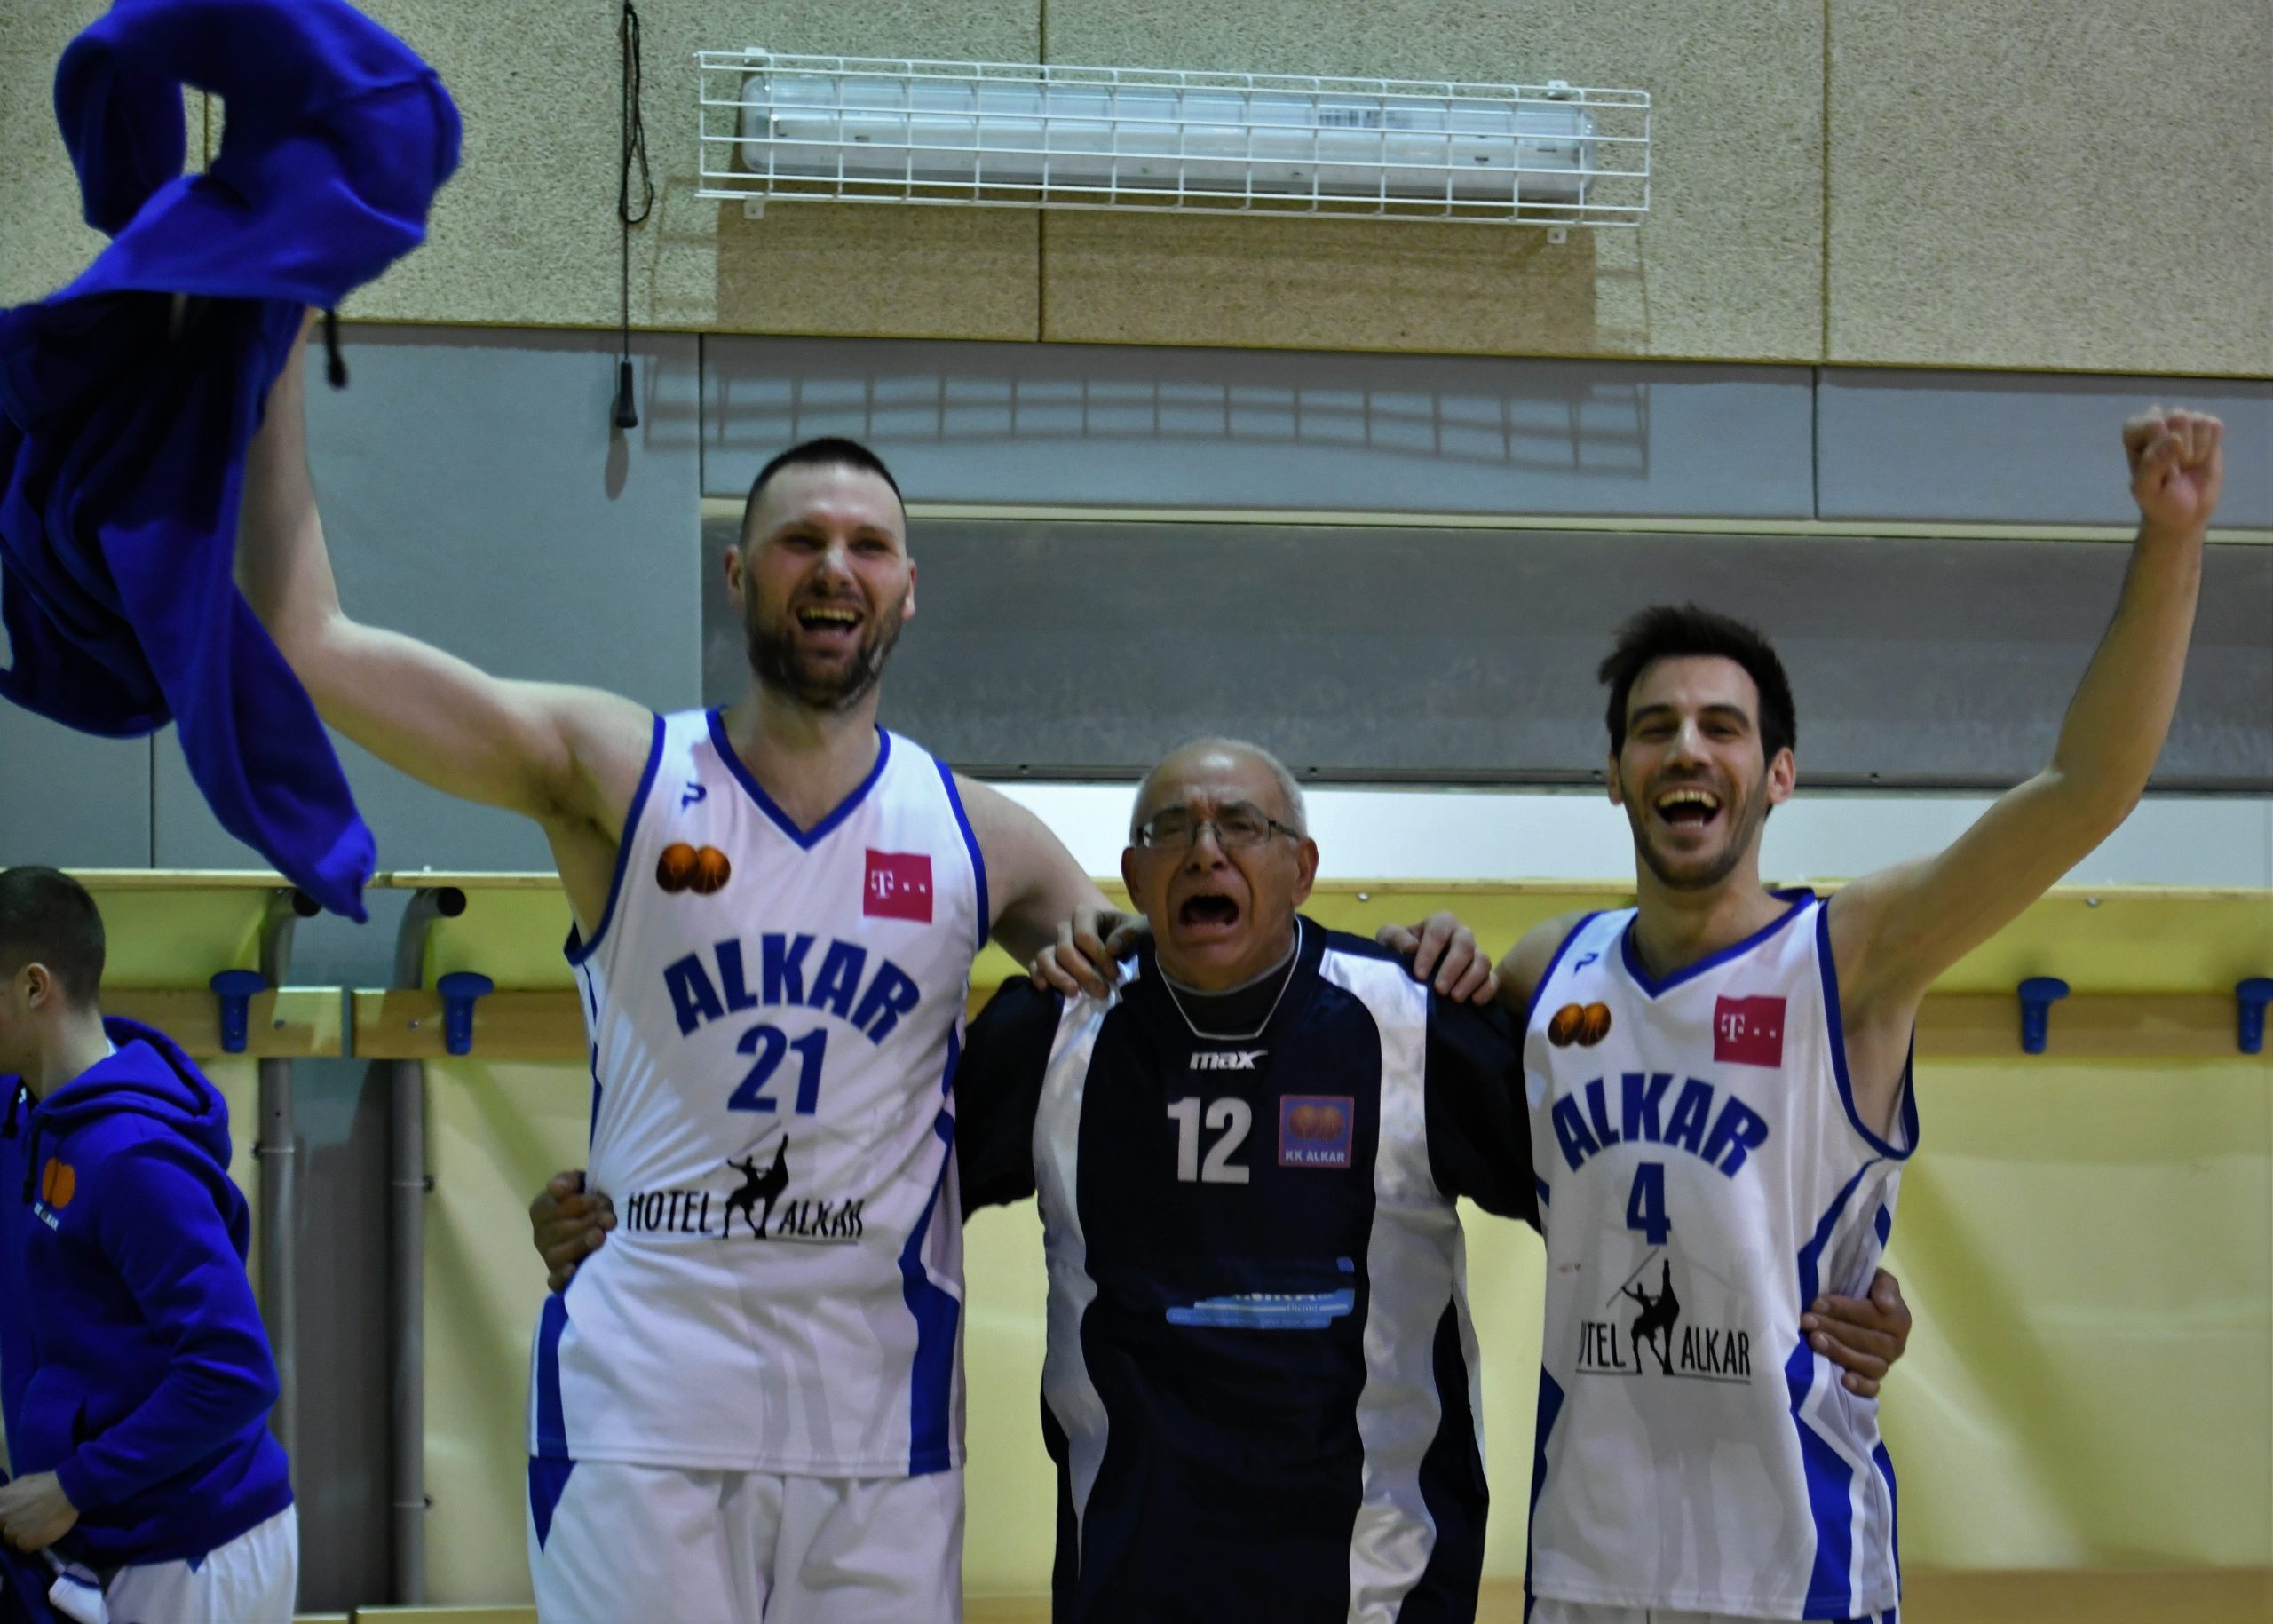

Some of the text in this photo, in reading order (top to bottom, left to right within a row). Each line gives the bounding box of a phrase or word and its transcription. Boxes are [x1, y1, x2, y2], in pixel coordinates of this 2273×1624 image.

[663, 932, 920, 1047] ALKAR
[727, 1024, 828, 1114] 21
[1189, 1050, 1269, 1070] max
[1167, 1096, 1252, 1184] 12
[1285, 1150, 1344, 1163] KK ALKAR
[1552, 1073, 1768, 1179] ALKAR
[627, 1191, 713, 1233] HOTEL
[1626, 1161, 1671, 1245] 4
[1681, 1325, 1750, 1375] ALKAR
